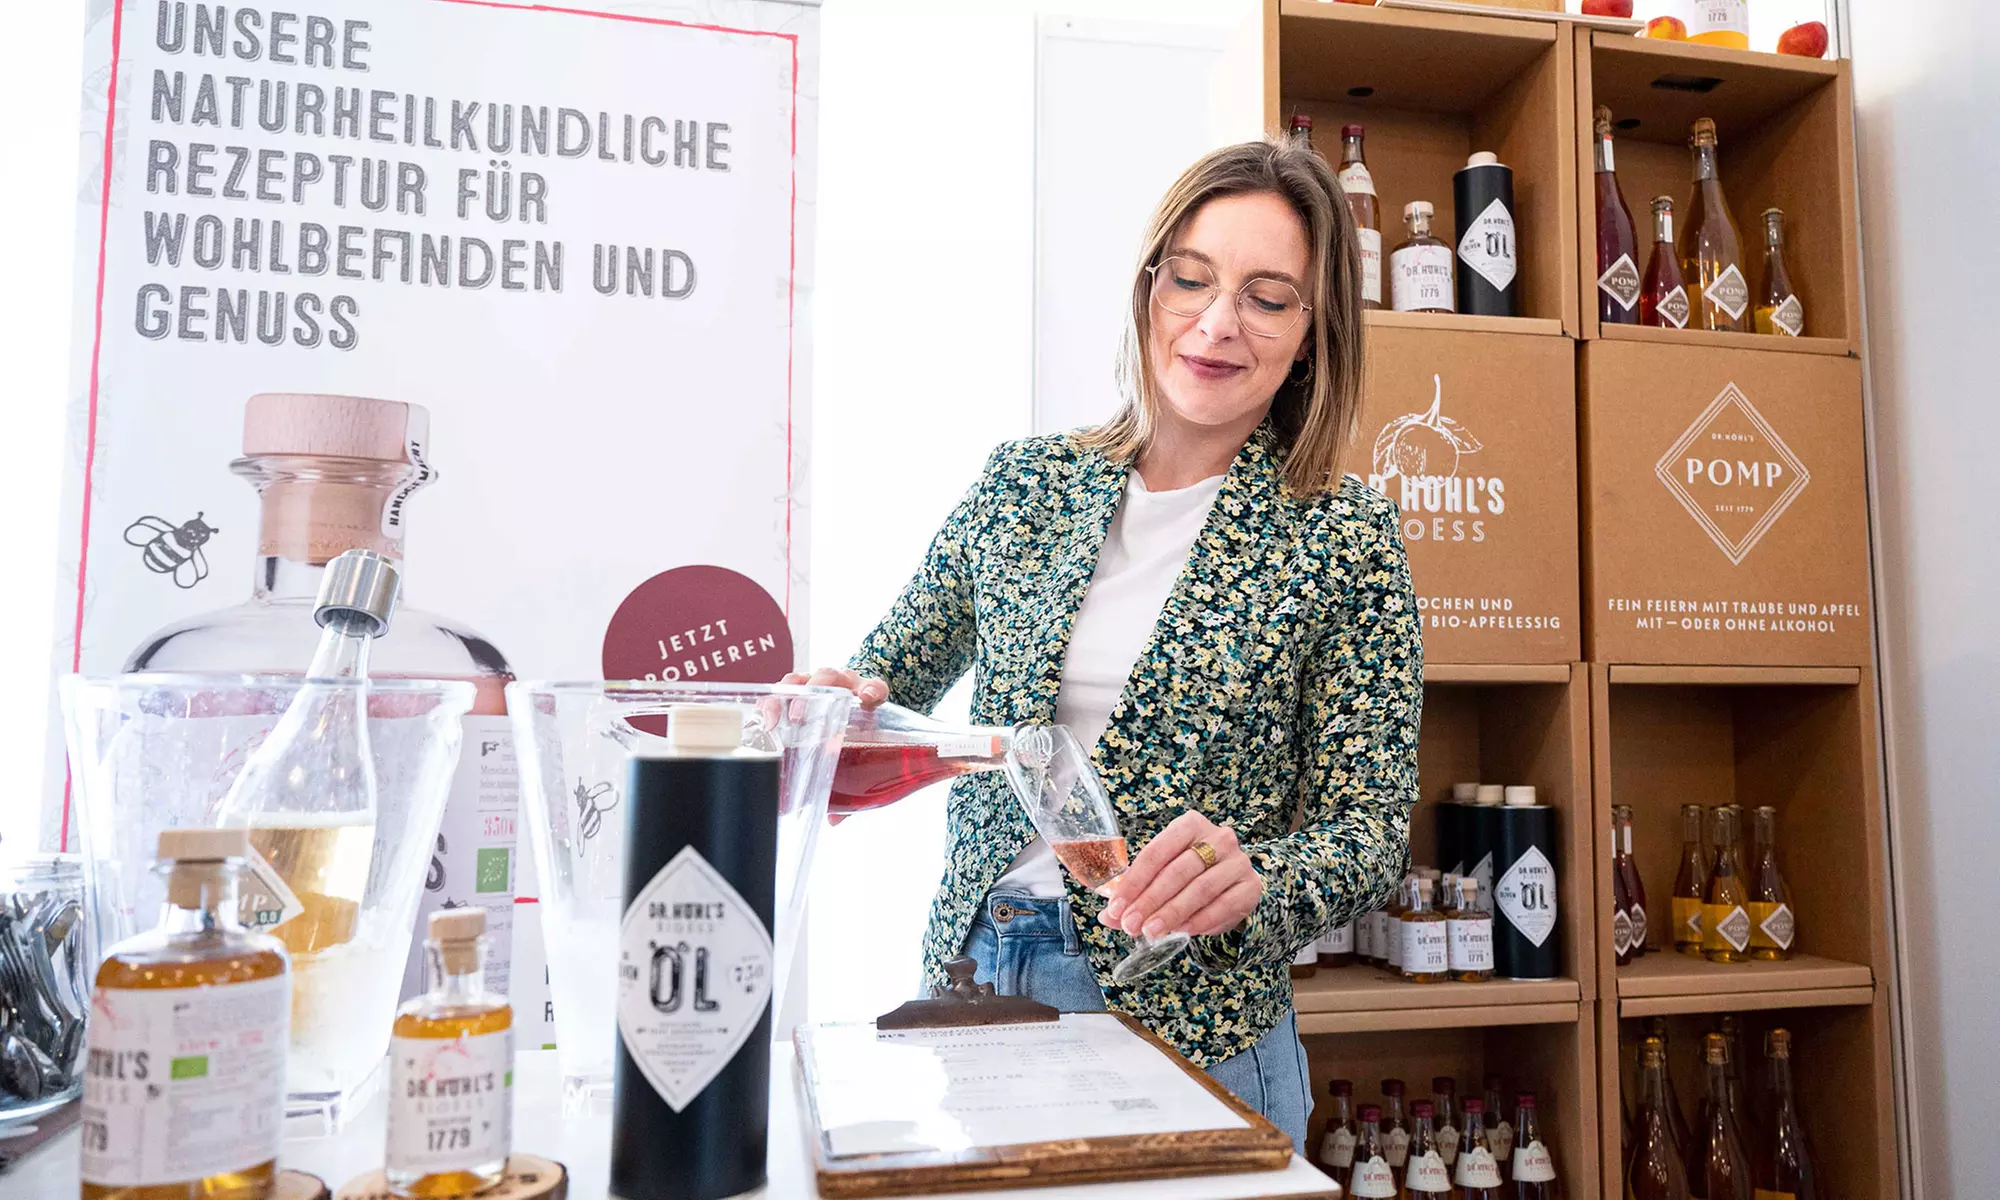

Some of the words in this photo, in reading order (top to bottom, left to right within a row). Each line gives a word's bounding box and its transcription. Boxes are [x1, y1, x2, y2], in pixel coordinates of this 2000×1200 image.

[155, 0, 373, 72] UNSERE
[151, 69, 732, 172] NATURHEILKUNDLICHE
[146, 139, 426, 215] REZEPTUR
[457, 159, 549, 224] FÜR
[143, 211, 564, 294] WOHLBEFINDEN
[592, 243, 699, 301] UND
[1420, 287, 1439, 299] 1779
[134, 283, 360, 351] GENUSS
[1686, 457, 1783, 488] POMP
[1403, 517, 1486, 543] OESS
[1415, 597, 1475, 611] OCHEN
[1480, 597, 1513, 611] UND
[1607, 598, 1641, 611] FEIN
[1646, 599, 1698, 613] FEIERN
[1702, 601, 1728, 613] MIT
[1732, 602, 1784, 615] TRAUBE
[1788, 603, 1818, 616] UND
[1821, 604, 1861, 617] APFEL
[1431, 615, 1561, 629] BIO-APFELESSIG
[1681, 617, 1720, 631] ODER
[1725, 619, 1766, 632] OHNE
[1770, 619, 1836, 633] ALKOHOL
[657, 619, 729, 661] JETZT
[1519, 881, 1549, 911] ÖL
[648, 938, 721, 1014] ÖL
[428, 1127, 471, 1152] 1779
